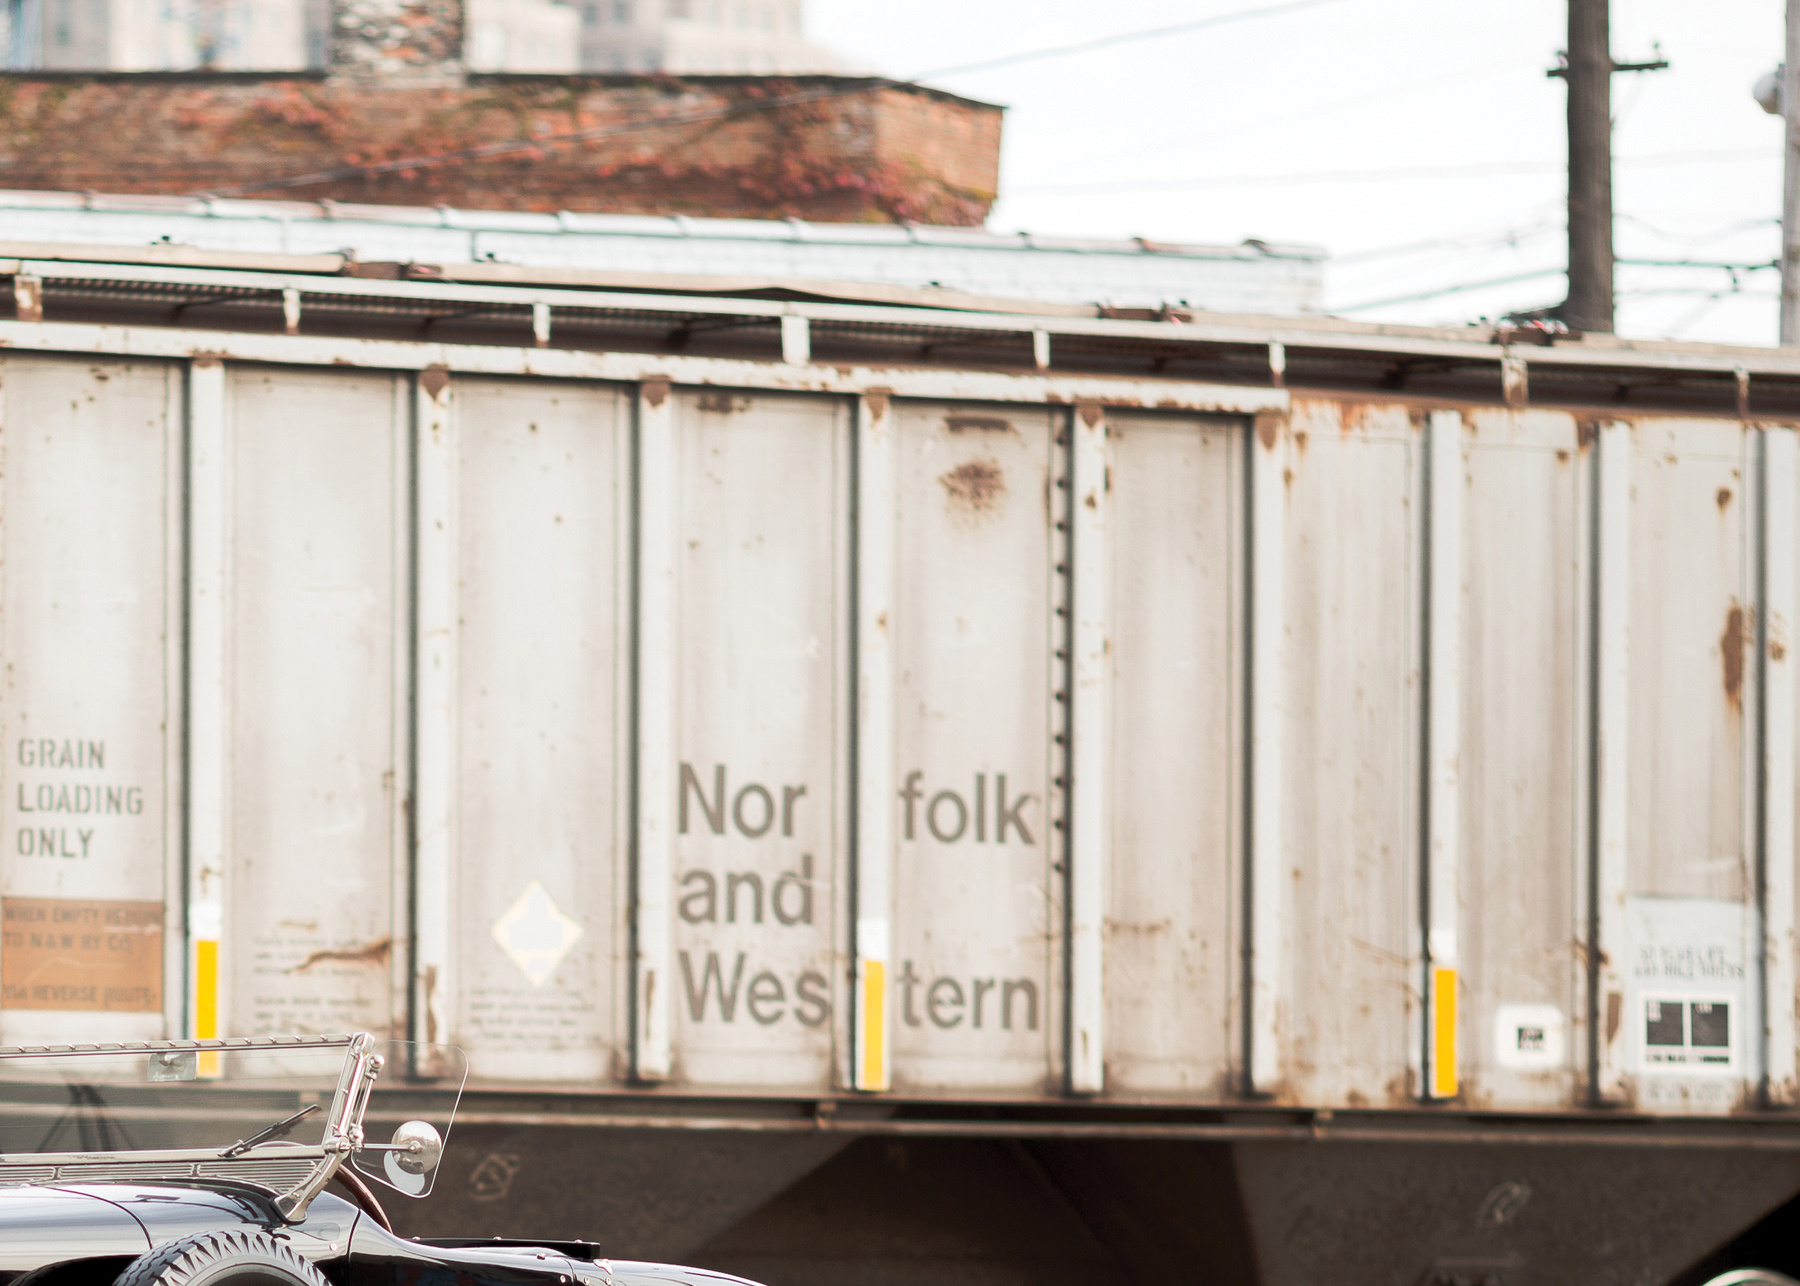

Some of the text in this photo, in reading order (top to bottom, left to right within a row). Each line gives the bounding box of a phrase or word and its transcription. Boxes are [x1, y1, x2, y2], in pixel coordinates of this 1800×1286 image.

[17, 738, 106, 770] GRAIN
[17, 782, 143, 815] LOADING
[678, 762, 1036, 845] Nor folk
[17, 827, 95, 858] ONLY
[678, 854, 814, 926] and
[678, 950, 1039, 1031] Wes tern
